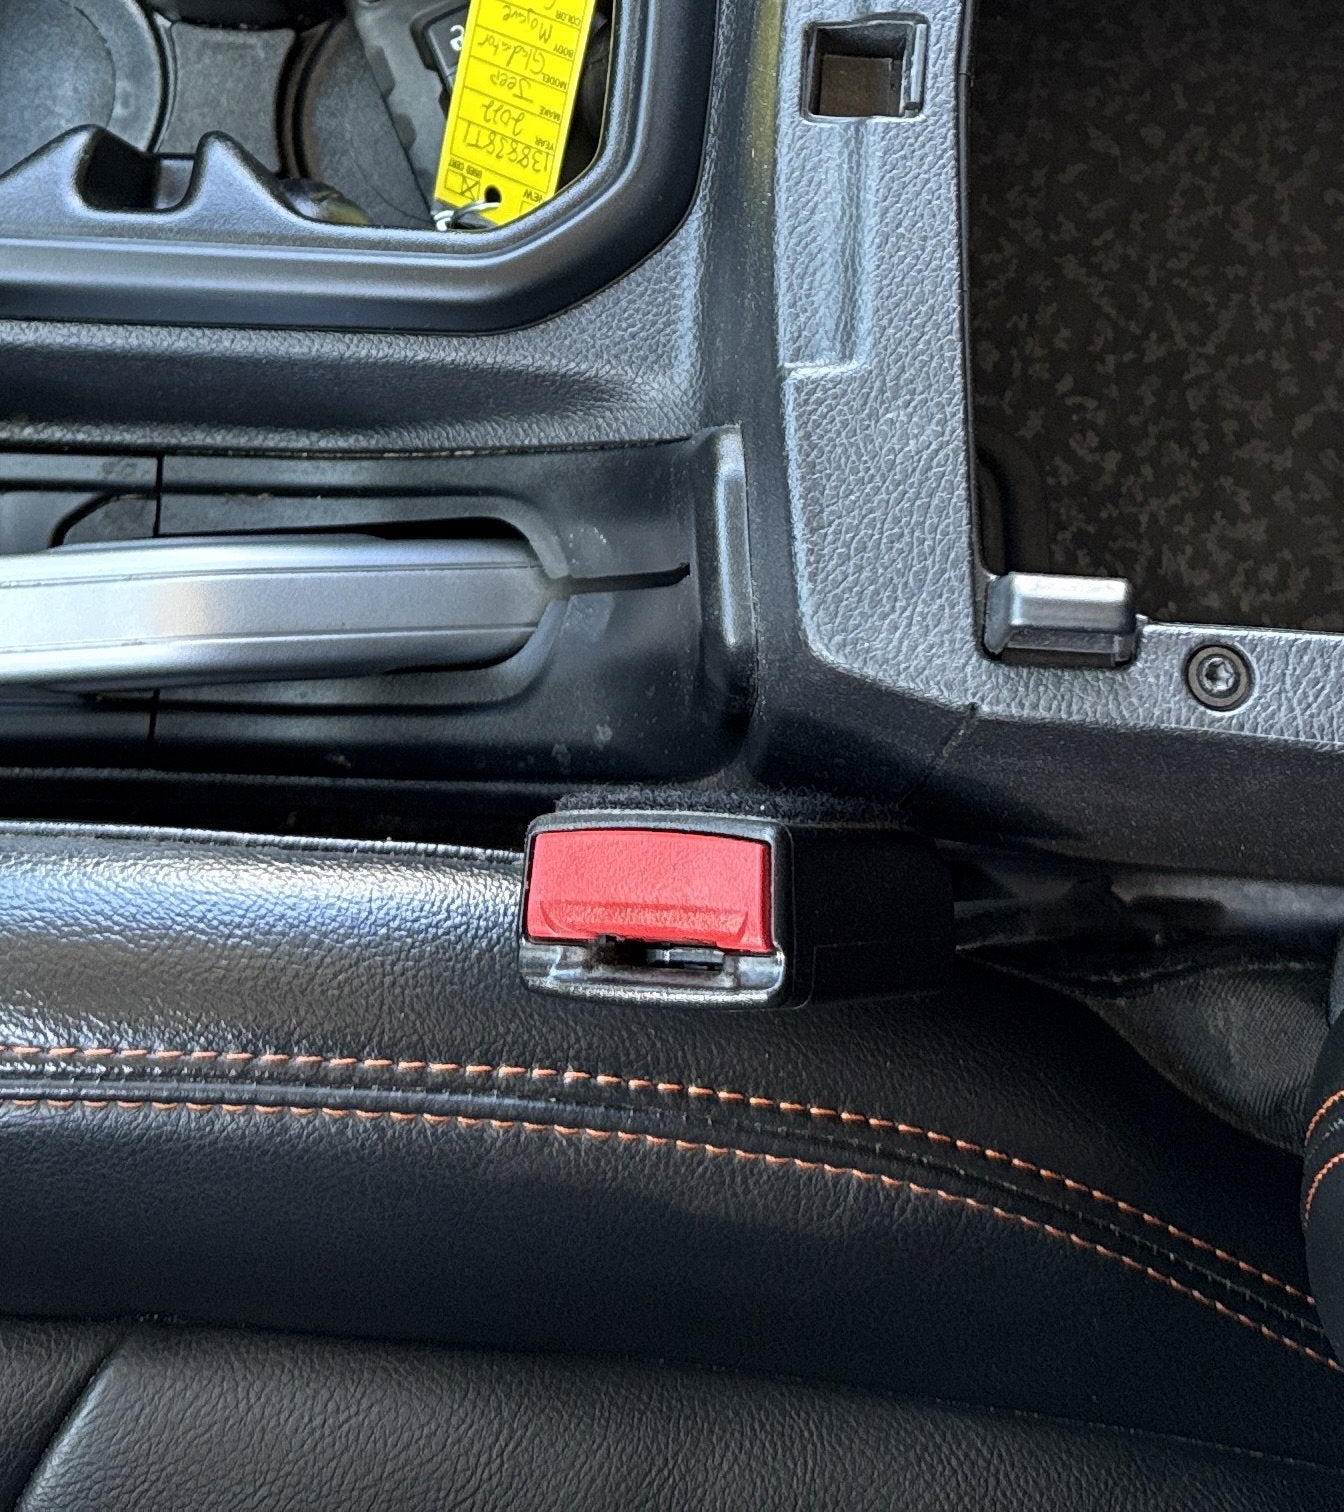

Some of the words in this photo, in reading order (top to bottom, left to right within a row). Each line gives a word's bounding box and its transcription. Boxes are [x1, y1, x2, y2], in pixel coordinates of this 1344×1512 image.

[502, 4, 553, 44] Mojave
[556, 10, 581, 26] COLOR
[553, 44, 574, 58] BODY
[542, 72, 567, 89] MODEL
[482, 99, 525, 136] 2022
[539, 105, 561, 121] MAKE
[535, 136, 554, 150] YEAR
